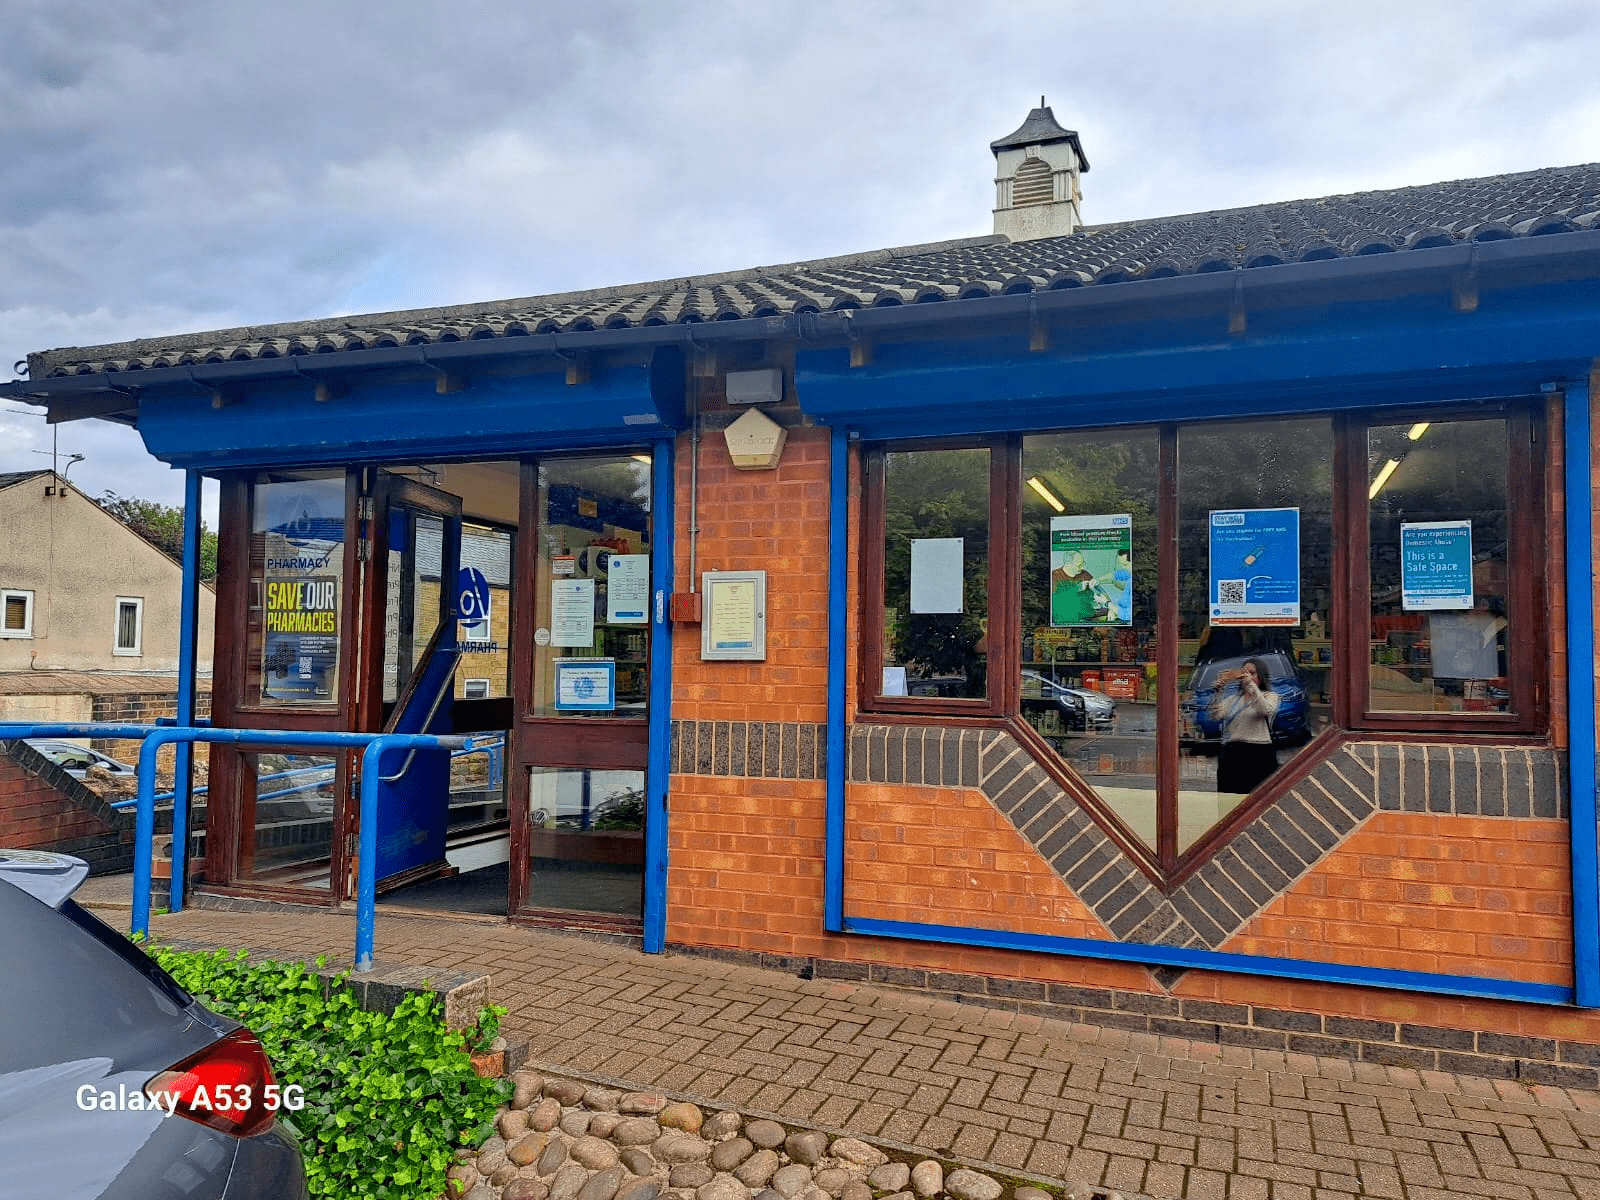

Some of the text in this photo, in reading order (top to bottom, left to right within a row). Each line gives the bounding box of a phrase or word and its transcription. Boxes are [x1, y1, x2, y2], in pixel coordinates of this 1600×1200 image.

[1406, 551, 1444, 560] This is a
[268, 558, 330, 568] PHARMACY
[1406, 562, 1427, 572] Safe
[268, 582, 334, 610] SAVE OUR
[267, 612, 334, 632] PHARMACIES
